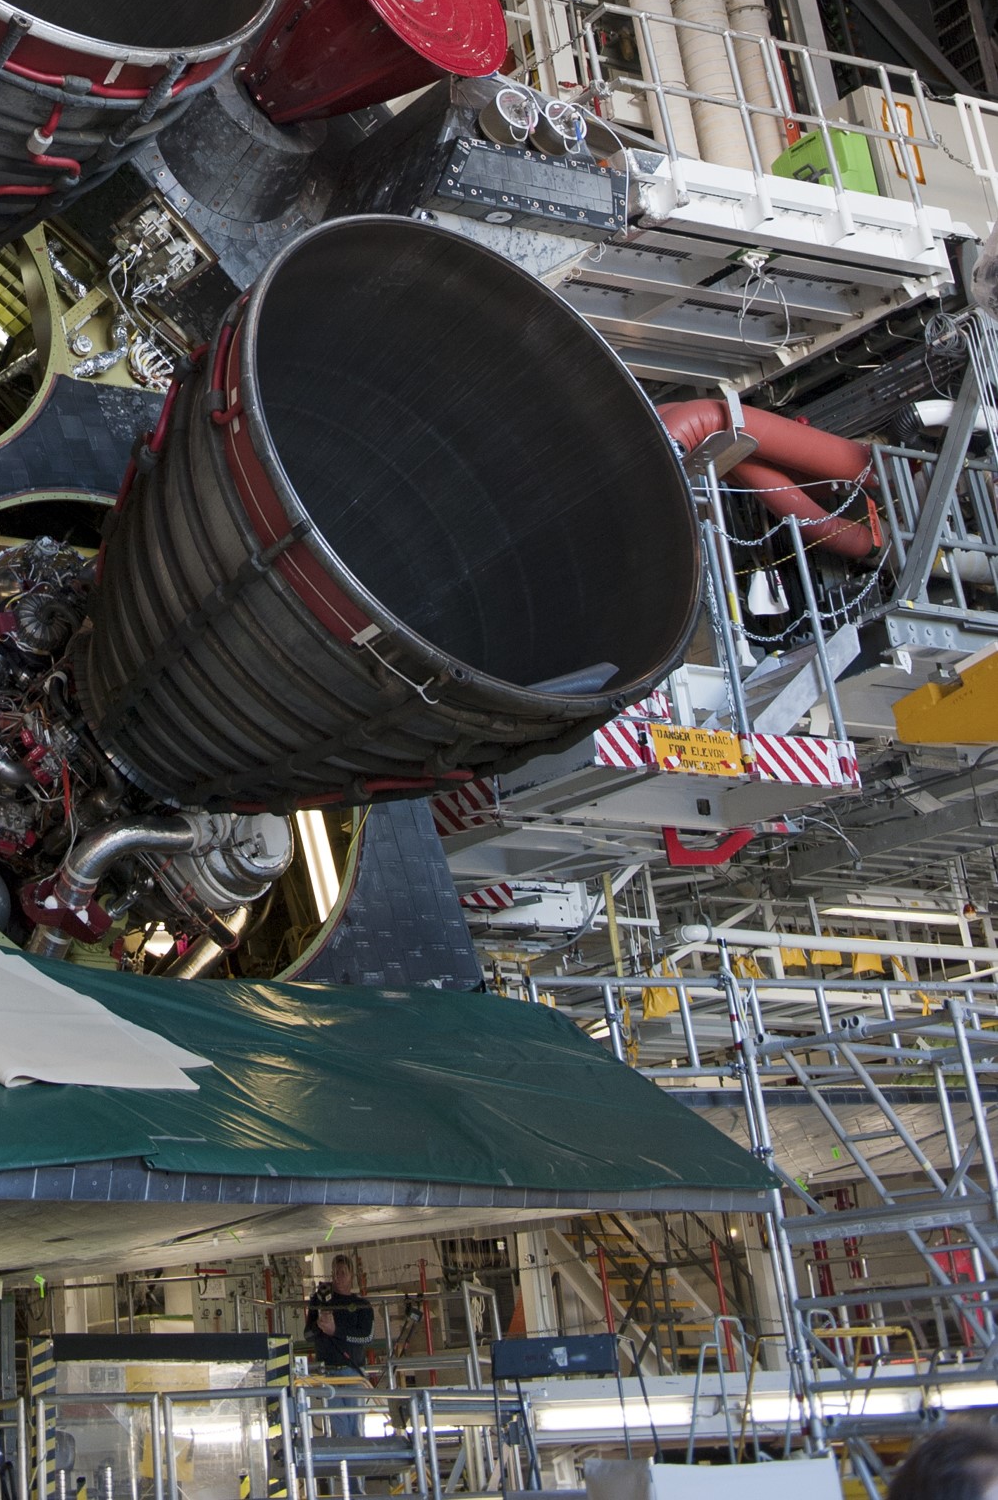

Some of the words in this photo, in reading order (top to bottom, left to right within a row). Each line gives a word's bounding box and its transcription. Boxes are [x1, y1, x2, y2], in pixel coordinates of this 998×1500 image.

[656, 730, 691, 742] DANGER
[695, 733, 733, 746] RETRACT
[668, 743, 687, 756] FOR
[691, 746, 725, 759] ELEVON
